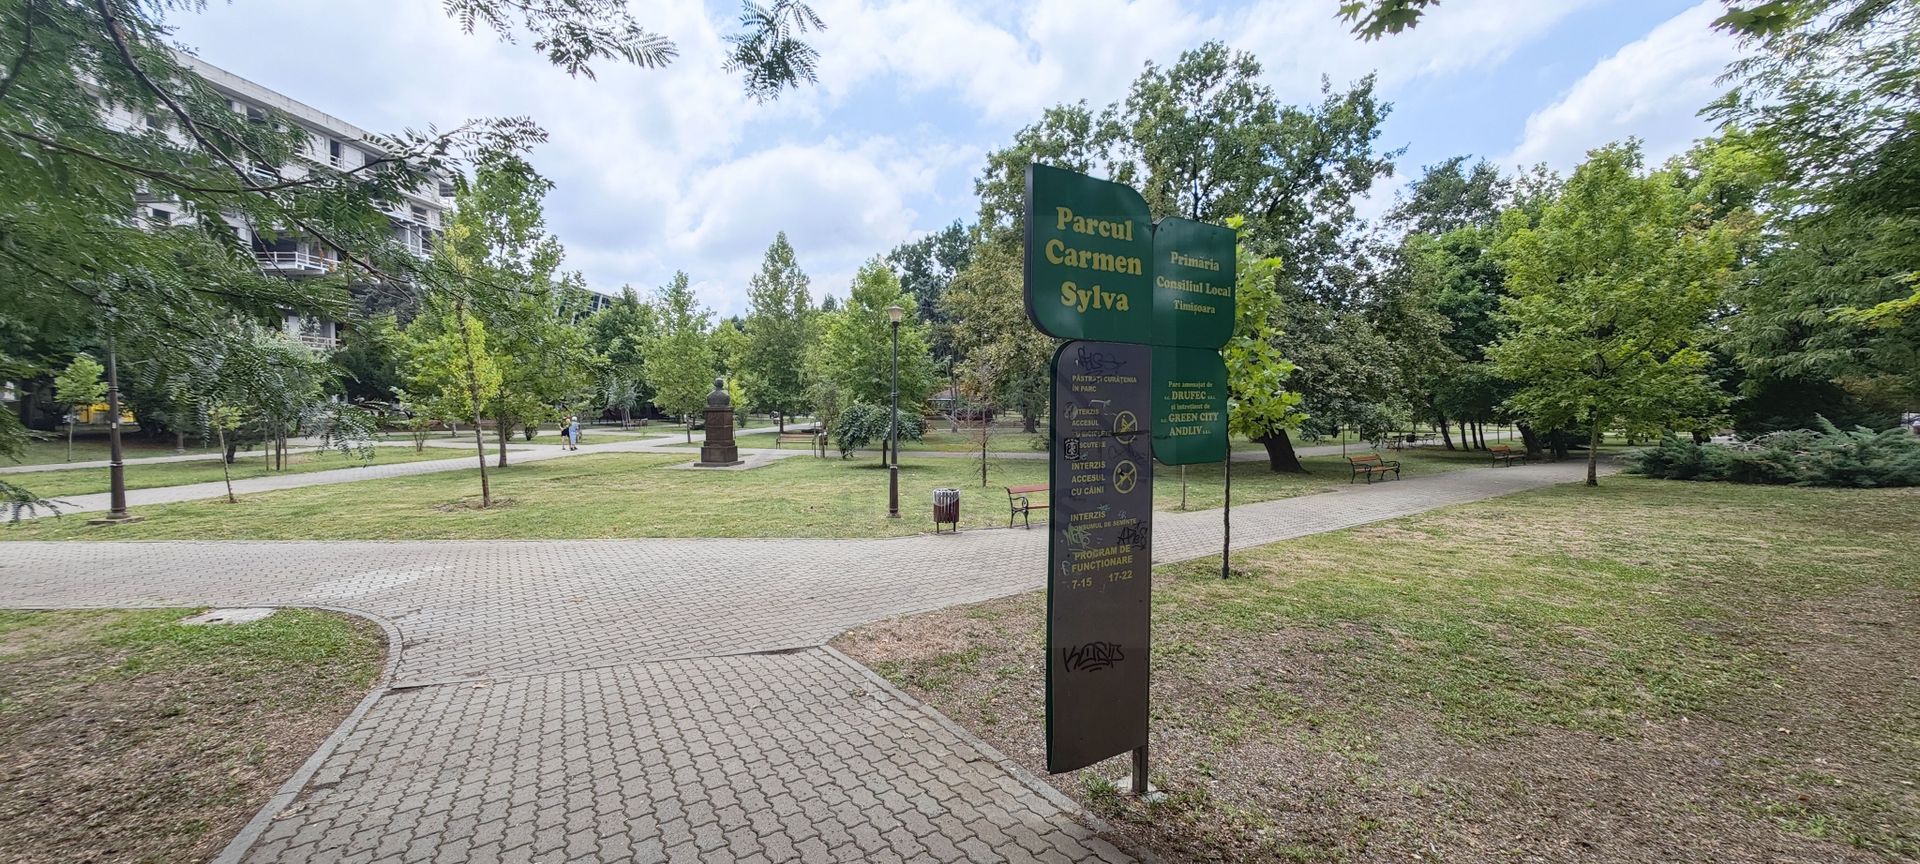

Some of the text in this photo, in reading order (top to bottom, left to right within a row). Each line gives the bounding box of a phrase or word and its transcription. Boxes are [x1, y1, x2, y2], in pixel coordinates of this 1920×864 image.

[1056, 206, 1133, 241] Parcul
[1045, 239, 1142, 275] Carmen
[1170, 251, 1220, 272] Primăria
[1156, 275, 1231, 297] Consiliul Local
[1060, 281, 1129, 313] Sylva
[1172, 299, 1216, 316] Timișoara
[1080, 384, 1097, 393] PARC
[1168, 380, 1181, 388] Parc
[1182, 381, 1206, 389] amenajat
[1171, 391, 1207, 400] DRUFEC
[1168, 413, 1198, 422] GREEN
[1199, 412, 1219, 421] CITY
[1169, 425, 1203, 436] ANDLIV
[1072, 461, 1106, 470] INTERZIS
[1072, 474, 1105, 483] ACCESUL
[1071, 488, 1082, 496] CU
[1070, 511, 1107, 521] INTERZIS
[1074, 544, 1131, 560] PROGRAM DE
[1071, 570, 1133, 589] 7-15 17-22
